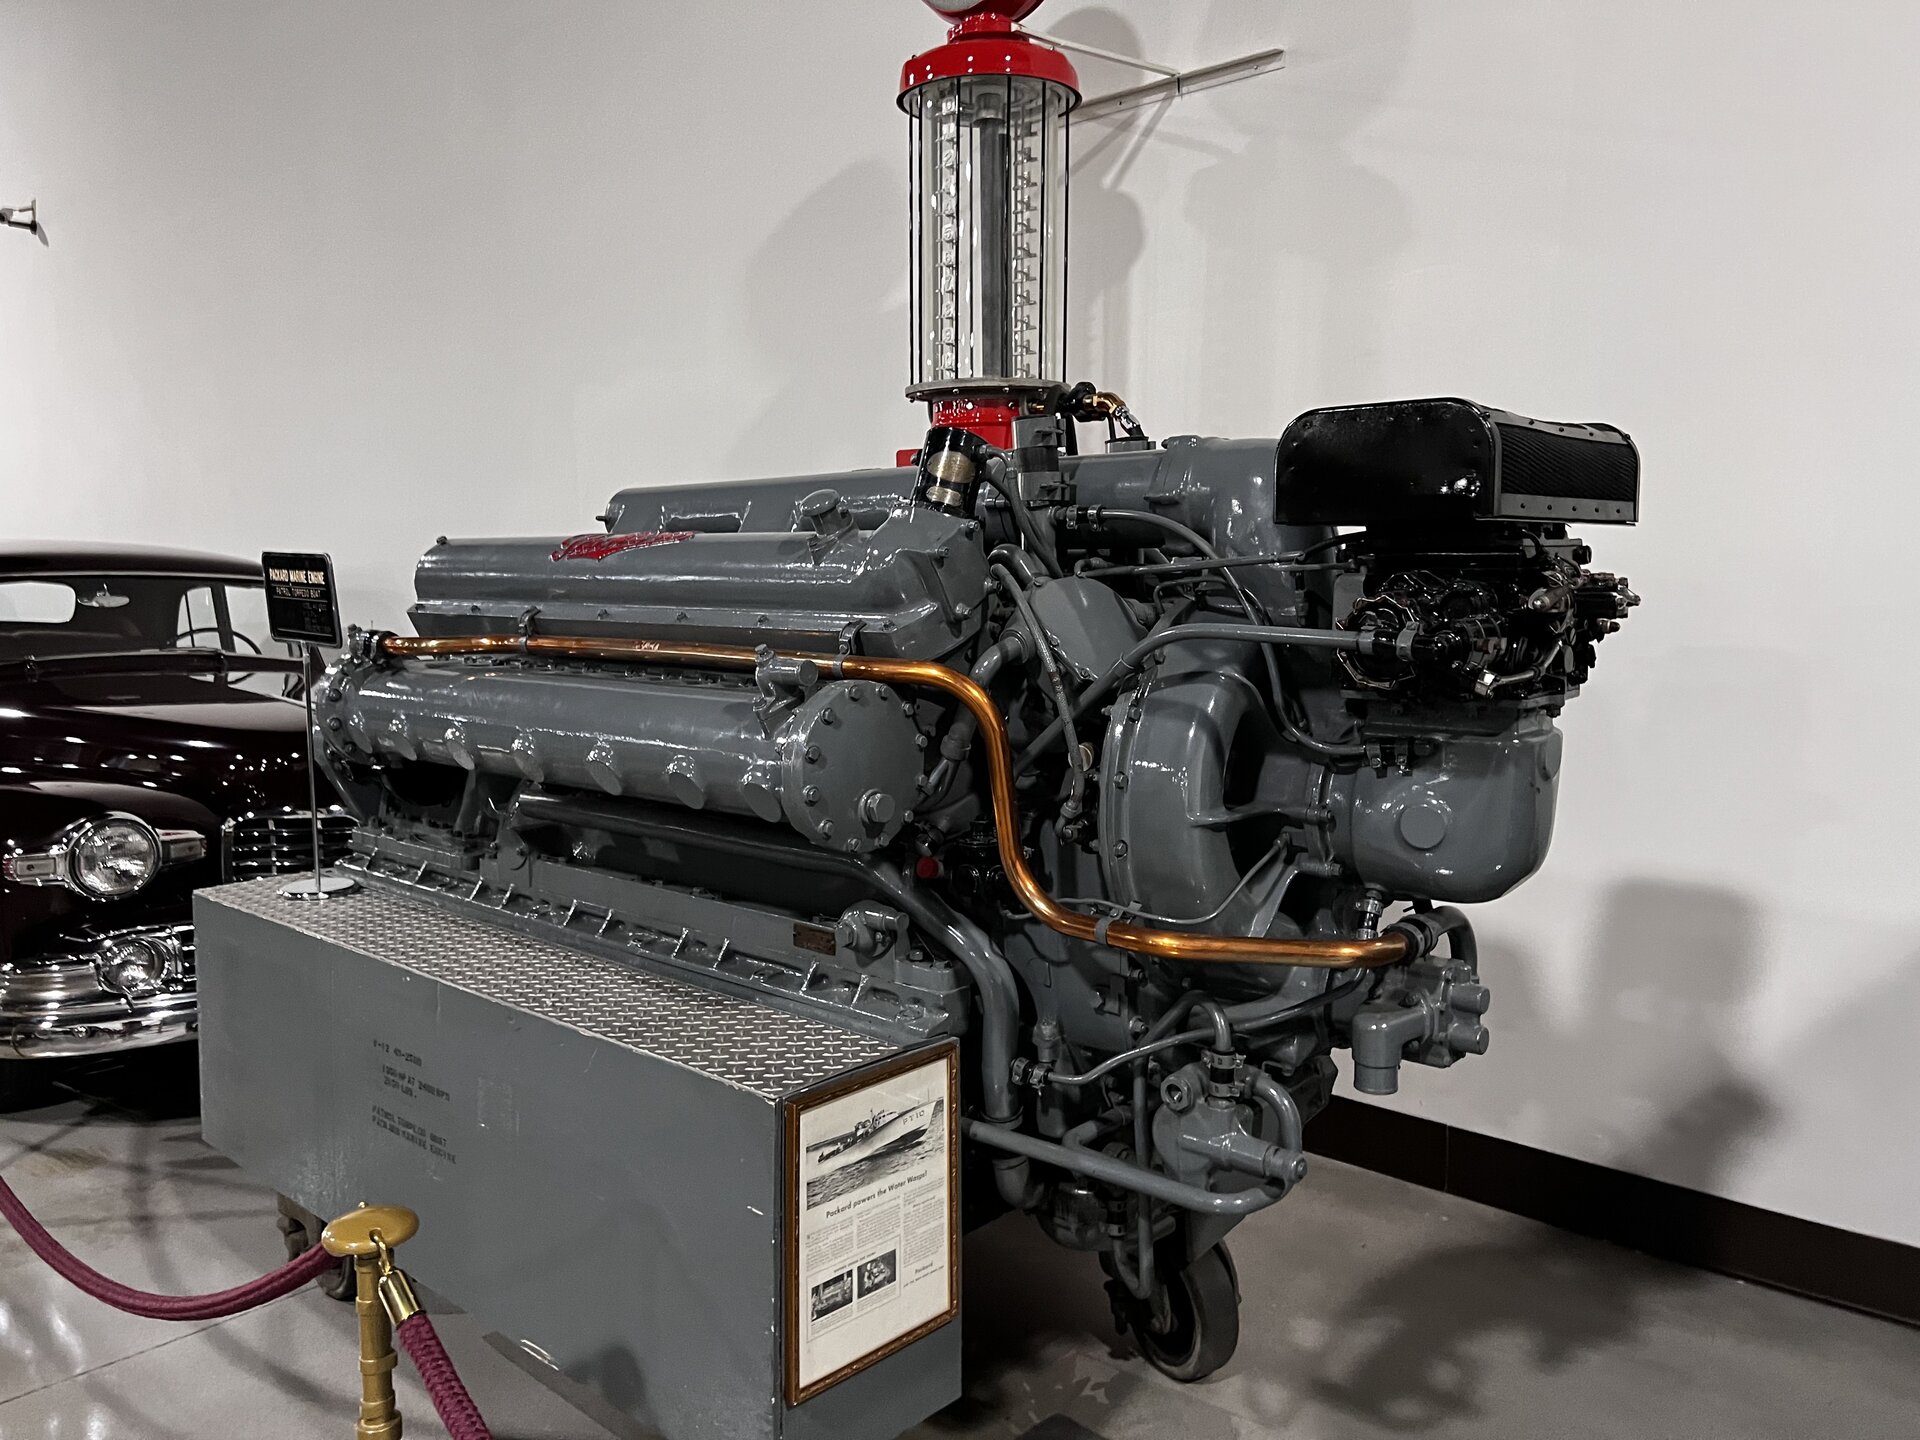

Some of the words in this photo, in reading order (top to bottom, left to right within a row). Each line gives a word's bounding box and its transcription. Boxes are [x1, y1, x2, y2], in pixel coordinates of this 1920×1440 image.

[269, 568, 289, 582] PACKARD
[289, 569, 307, 584] MARINE
[307, 570, 325, 585] ENGINE
[276, 587, 291, 597] PATROL
[291, 587, 310, 598] TORPEDO
[310, 588, 321, 598] BOAT
[826, 1201, 852, 1218] Packard
[853, 1193, 876, 1209] powers
[877, 1187, 887, 1197] the
[888, 1180, 906, 1192] Water
[907, 1170, 928, 1184] Wasps!
